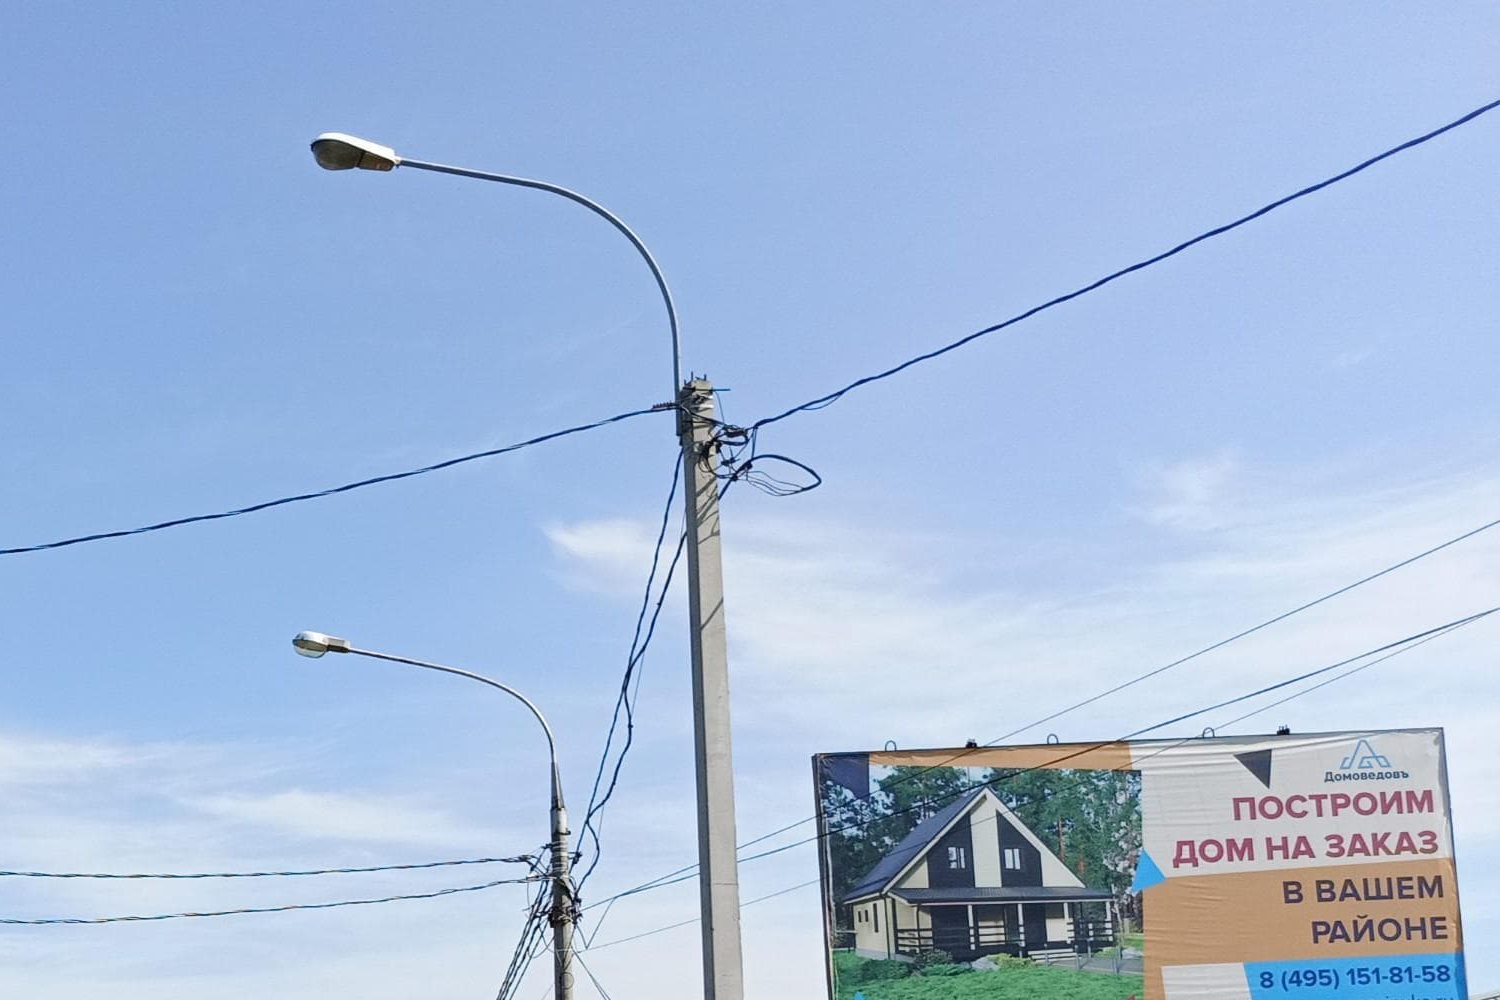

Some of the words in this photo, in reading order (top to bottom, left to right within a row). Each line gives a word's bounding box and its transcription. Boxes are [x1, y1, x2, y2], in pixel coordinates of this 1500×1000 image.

[1324, 769, 1409, 782] Домоведовъ
[1232, 789, 1435, 821] ПОСТРОИМ
[1172, 838, 1255, 868] ДОМ
[1265, 835, 1317, 861] НА
[1323, 830, 1439, 858] ЗАКАЗ
[1282, 881, 1304, 904] В
[1315, 875, 1444, 902] ВАШЕМ
[1311, 914, 1449, 944] РАЙОНЕ
[1259, 971, 1274, 989] 8
[1281, 968, 1340, 991] (495)
[1346, 965, 1450, 986] 151-81-58
